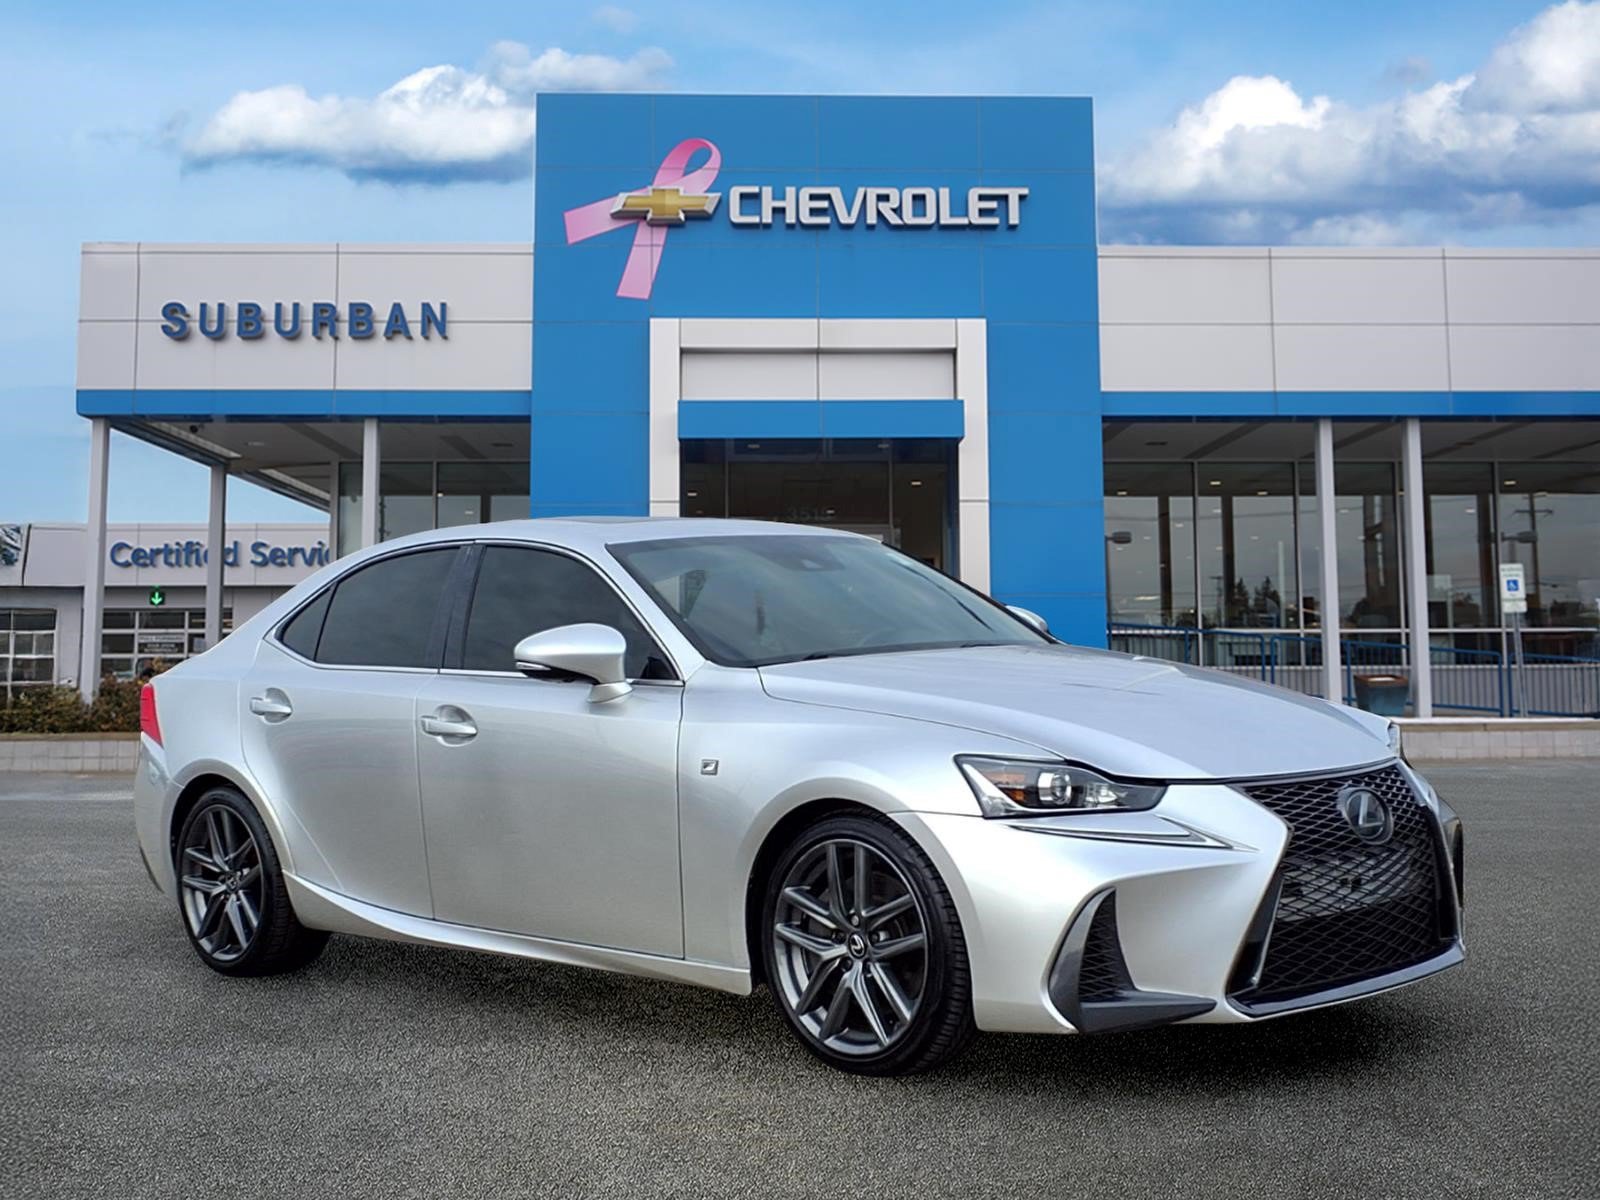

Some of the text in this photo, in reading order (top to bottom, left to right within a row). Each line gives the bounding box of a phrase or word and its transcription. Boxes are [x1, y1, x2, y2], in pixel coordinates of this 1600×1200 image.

[729, 185, 1029, 227] CHEVROLET
[160, 301, 449, 341] SUBURBAN
[110, 541, 329, 568] Certifid Servi
